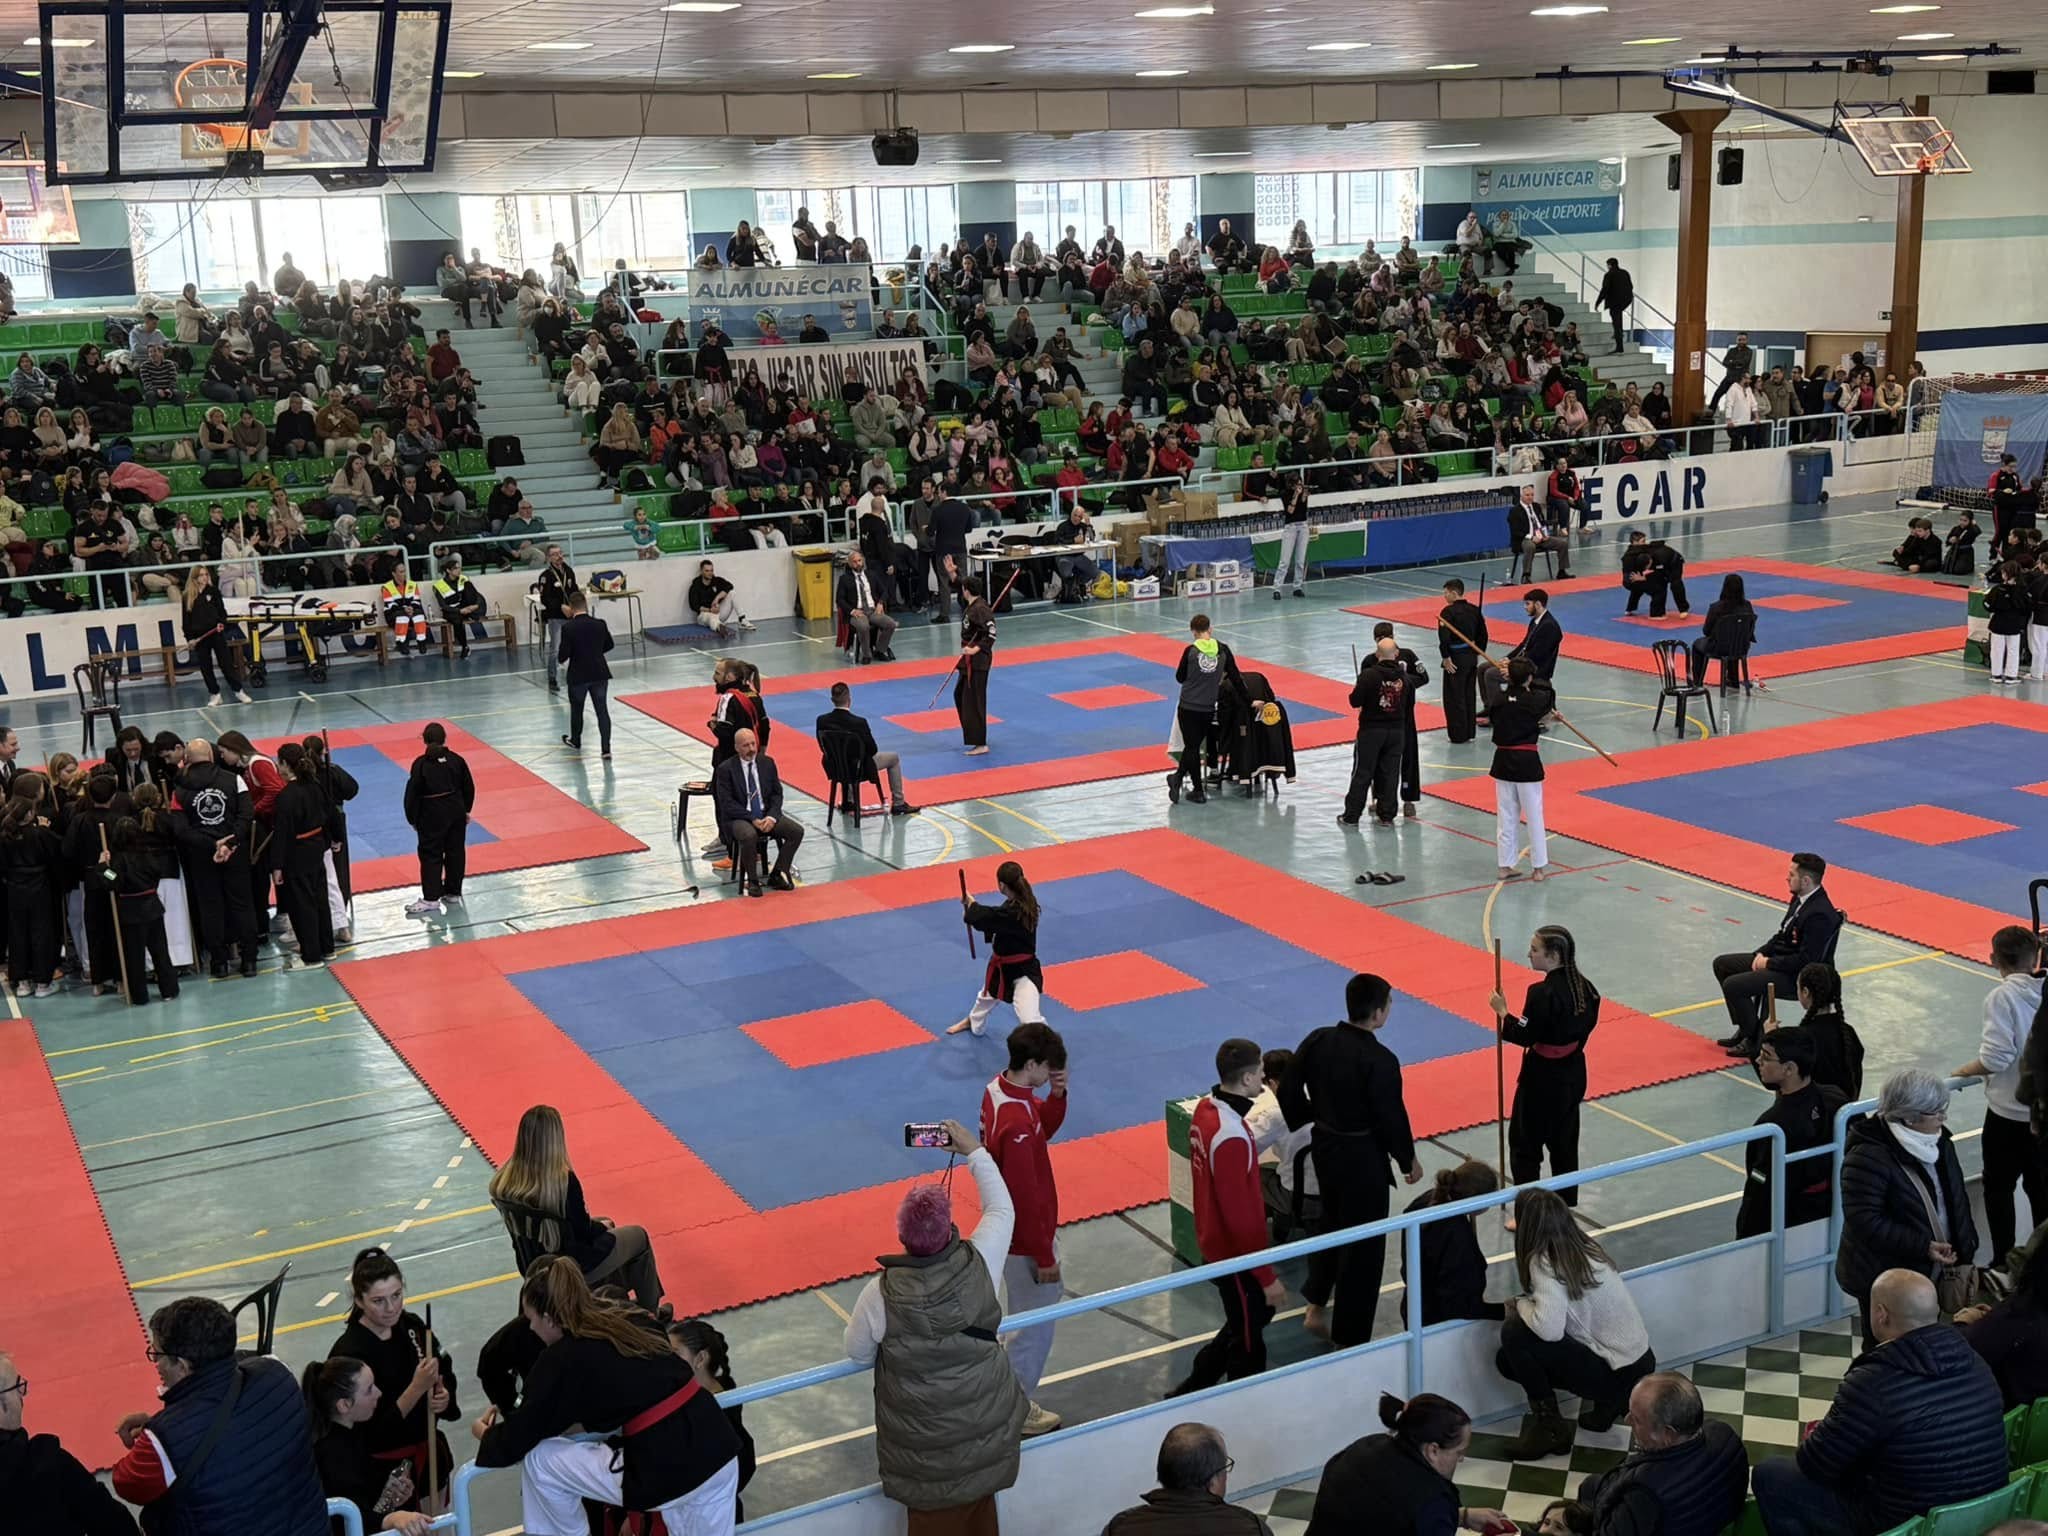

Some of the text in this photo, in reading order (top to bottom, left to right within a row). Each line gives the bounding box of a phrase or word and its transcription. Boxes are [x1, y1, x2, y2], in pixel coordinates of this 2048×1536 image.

[1552, 203, 1601, 219] DEPORTE
[695, 275, 862, 298] ALMUÑÉCAR
[819, 353, 844, 400] SIN
